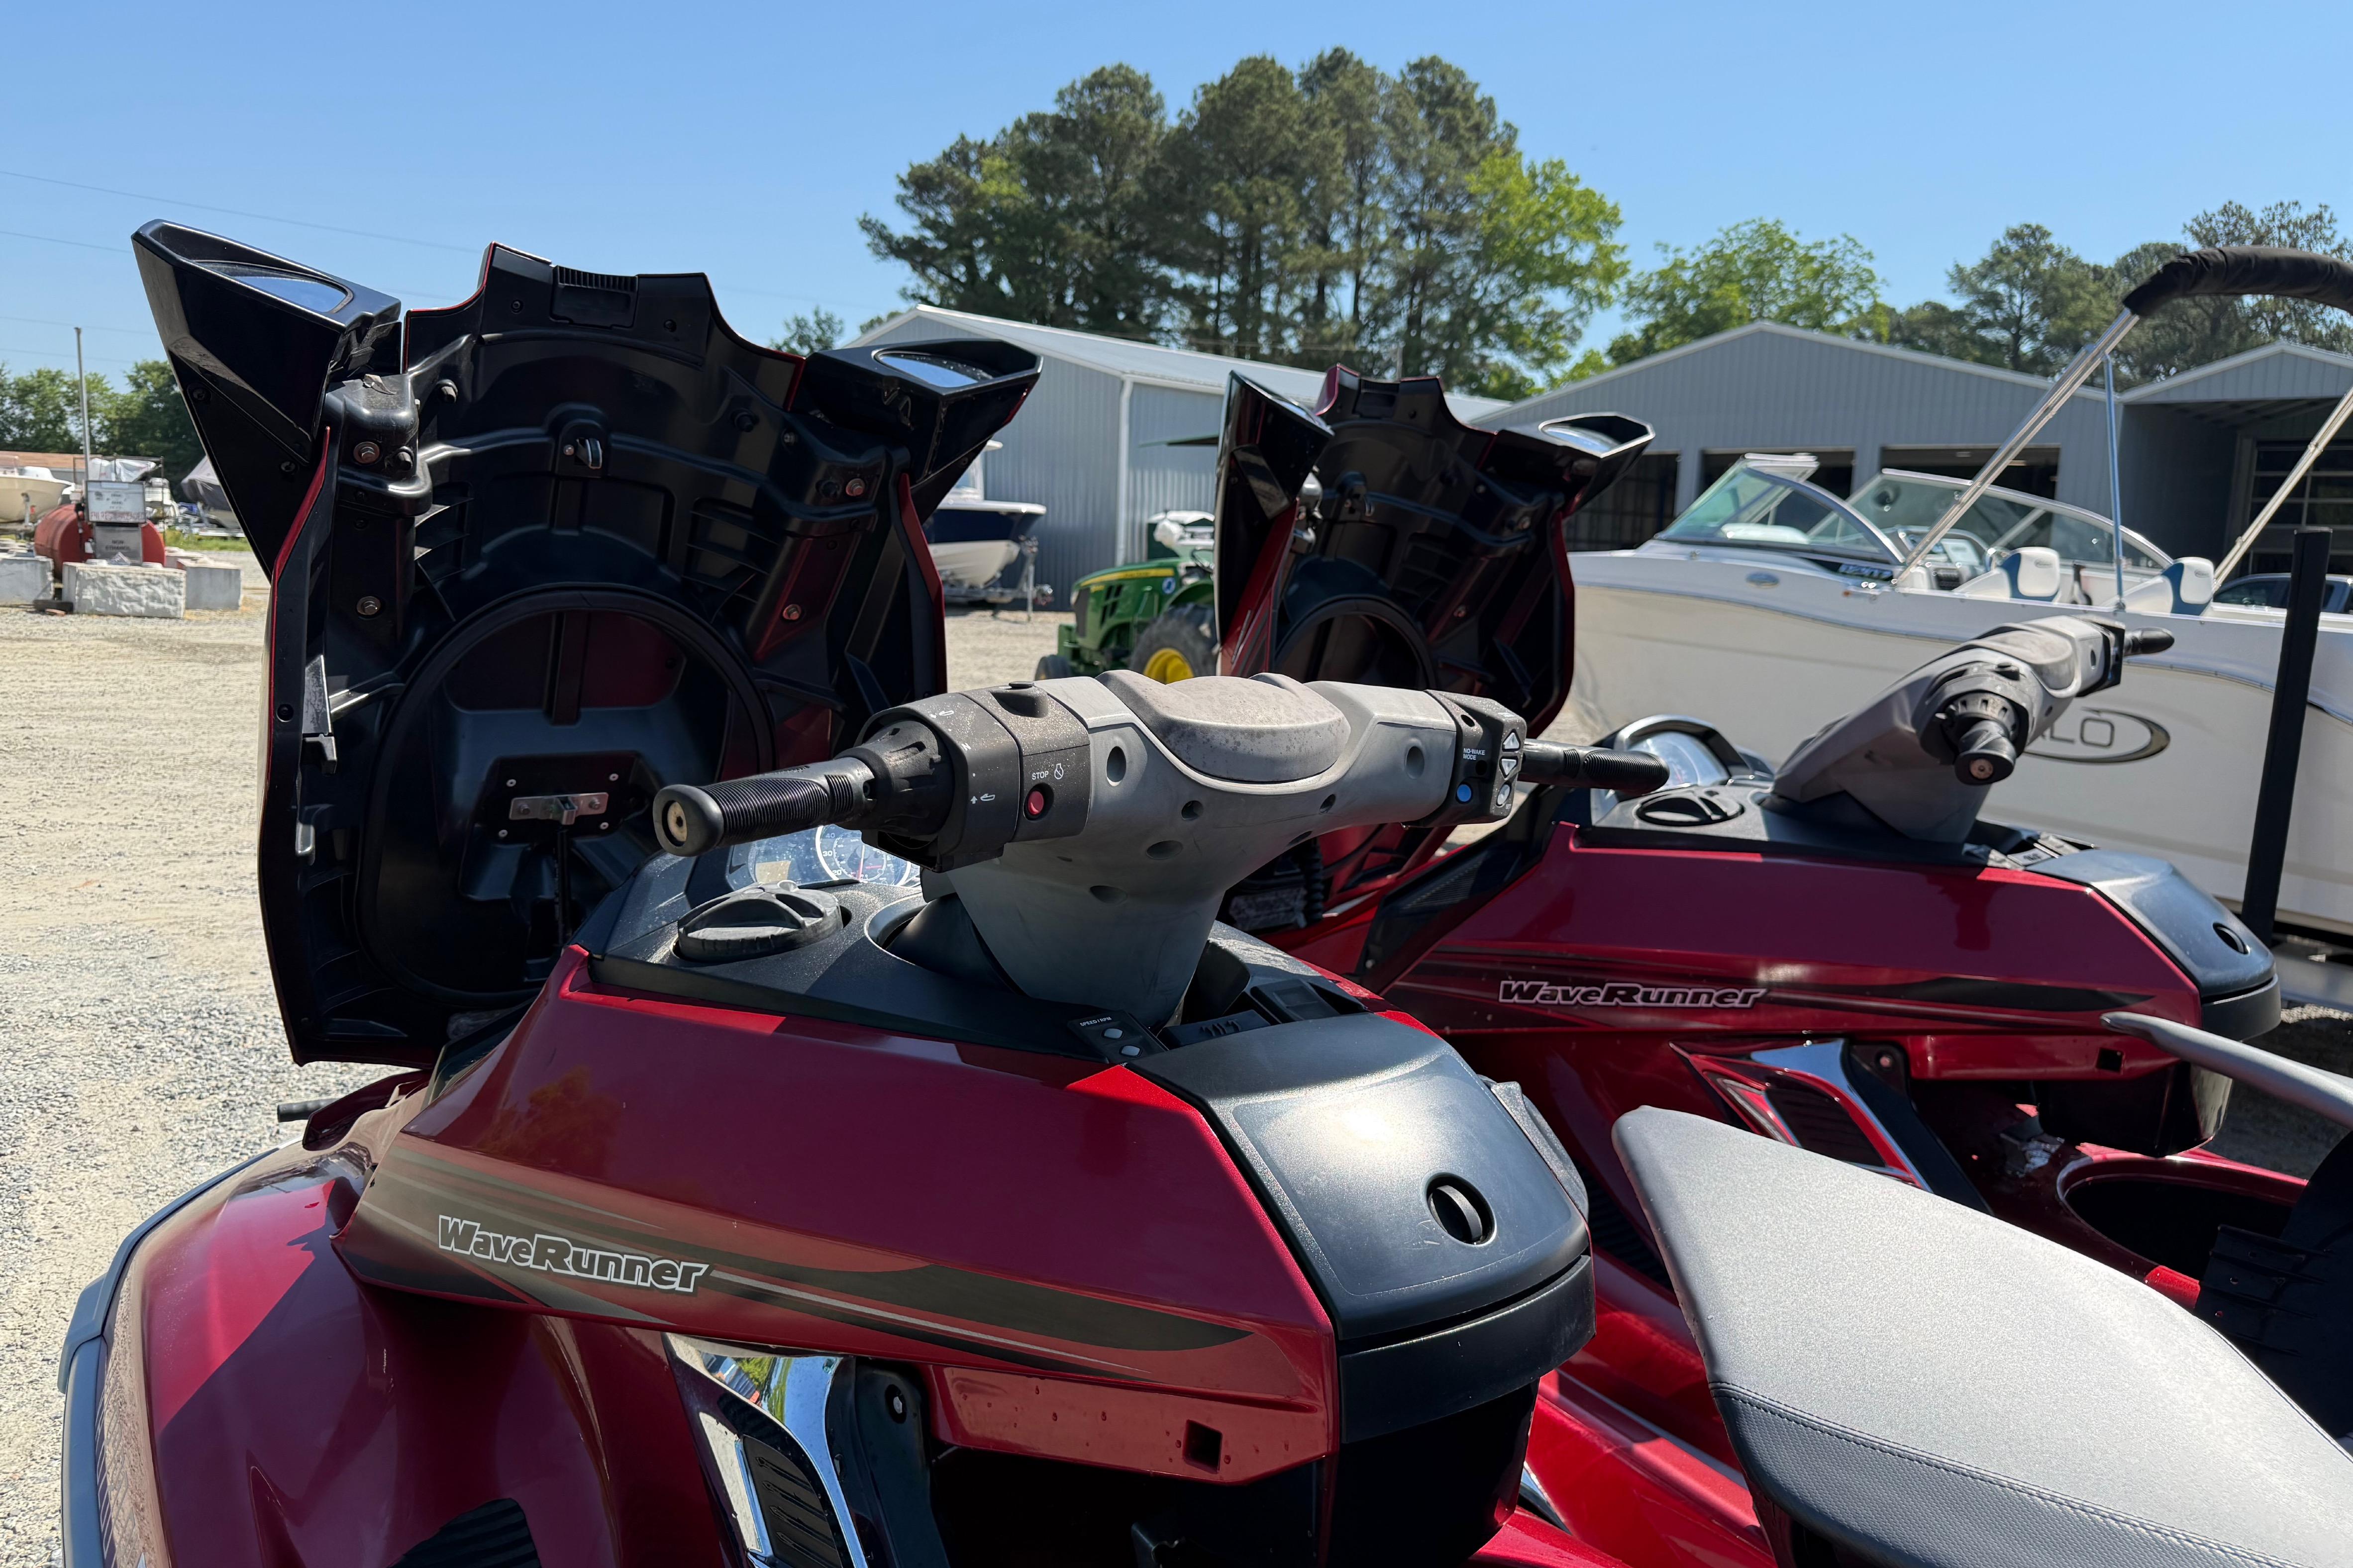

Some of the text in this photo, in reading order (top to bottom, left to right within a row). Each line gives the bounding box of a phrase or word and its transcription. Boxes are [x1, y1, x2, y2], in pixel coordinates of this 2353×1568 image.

[1031, 771, 1049, 780] STOP
[1499, 980, 1768, 1008] WaveRunner
[439, 1215, 709, 1292] WaveRunner
